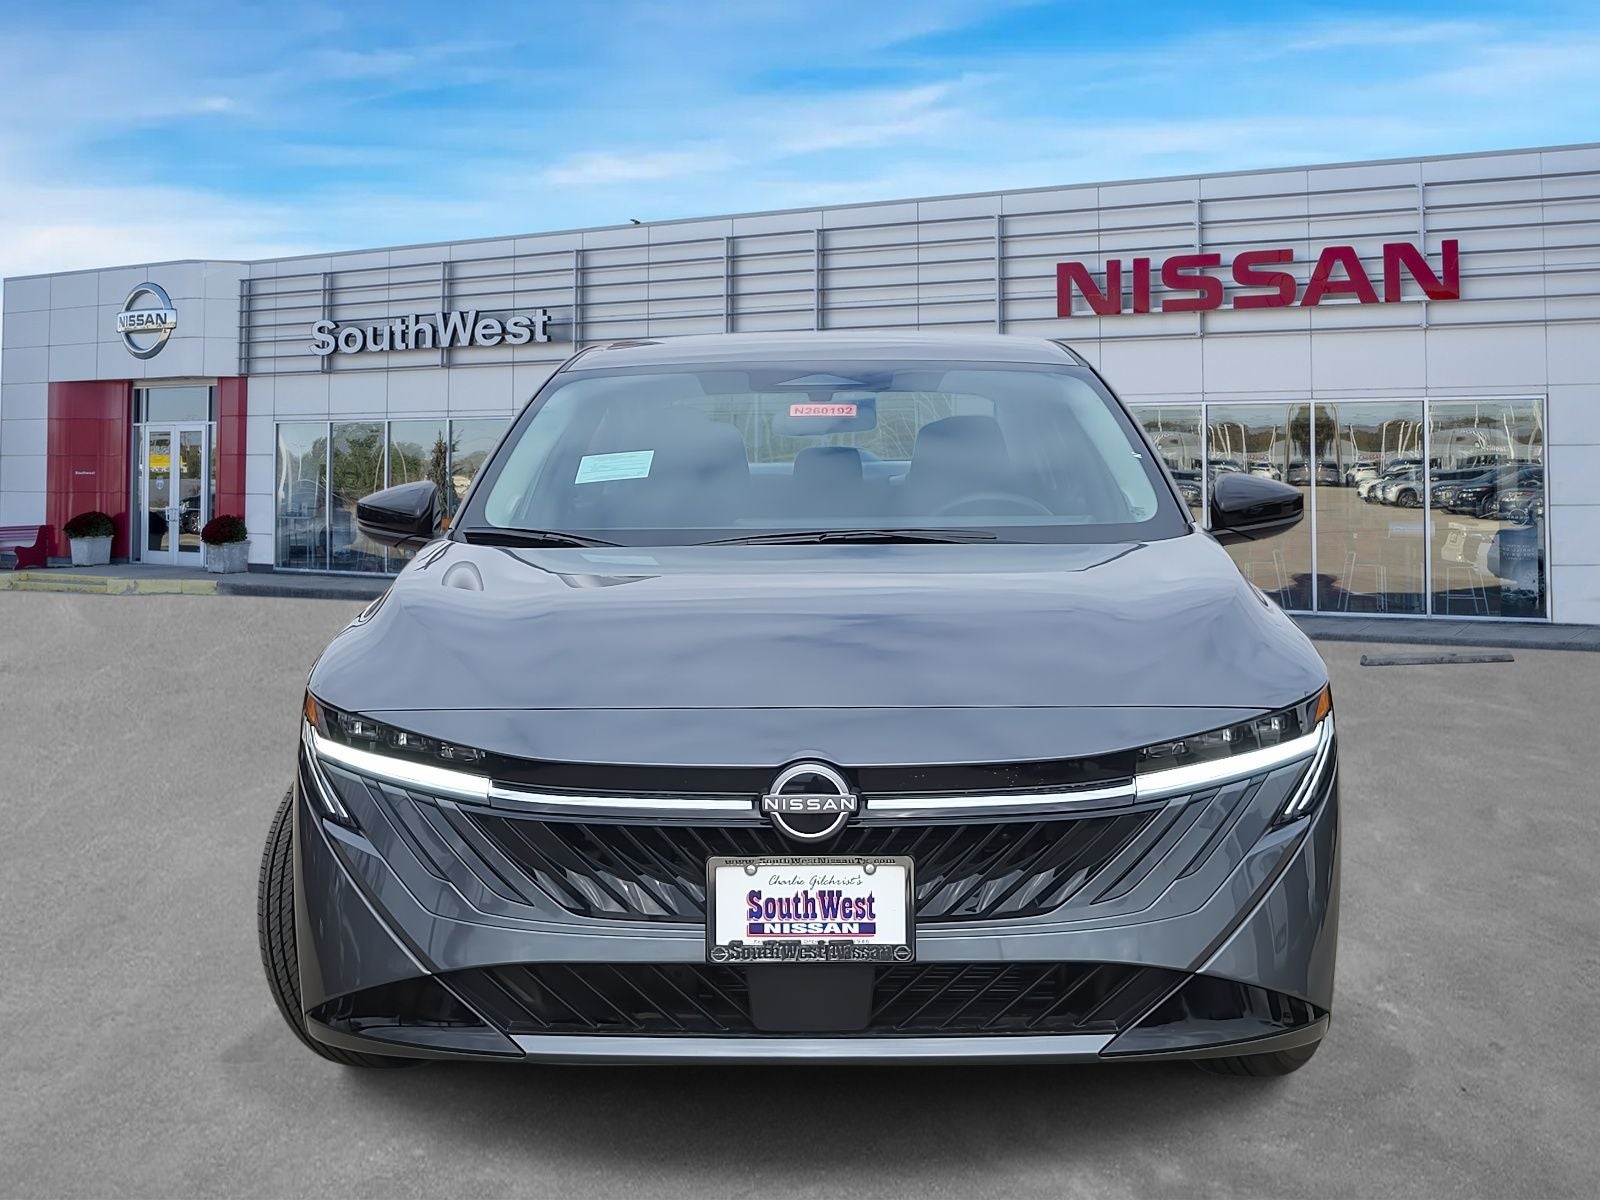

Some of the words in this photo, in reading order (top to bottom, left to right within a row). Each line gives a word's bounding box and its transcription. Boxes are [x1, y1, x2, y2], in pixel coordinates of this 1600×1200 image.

[1056, 239, 1460, 318] NISSAN
[119, 312, 167, 328] NISSAN
[309, 308, 552, 356] SouthWest
[794, 406, 853, 415] N260192
[764, 798, 855, 811] NISSAN
[768, 874, 805, 886] Charlie
[747, 890, 876, 921] SouthWest
[763, 923, 860, 934] NISSAN
